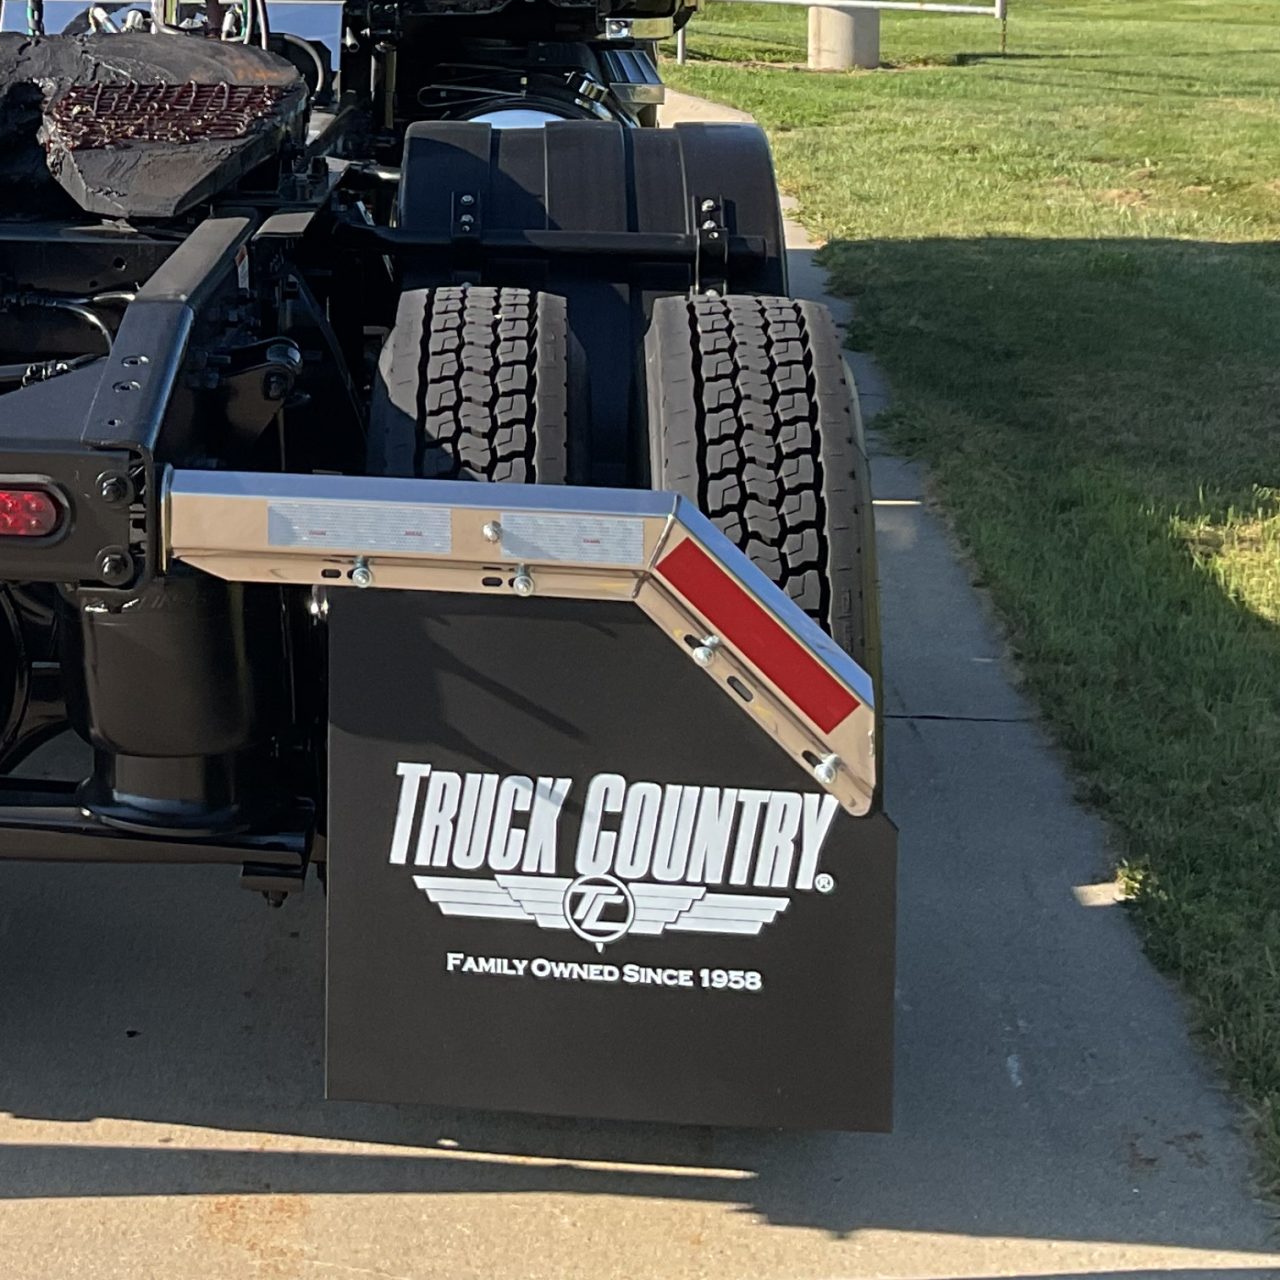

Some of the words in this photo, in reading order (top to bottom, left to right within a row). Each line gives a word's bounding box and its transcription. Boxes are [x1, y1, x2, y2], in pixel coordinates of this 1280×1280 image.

[389, 762, 573, 874] TRUCK
[447, 952, 528, 976] FAMILY
[531, 959, 619, 982] OWNED
[623, 963, 694, 987] SINCE
[700, 968, 762, 991] 1958
